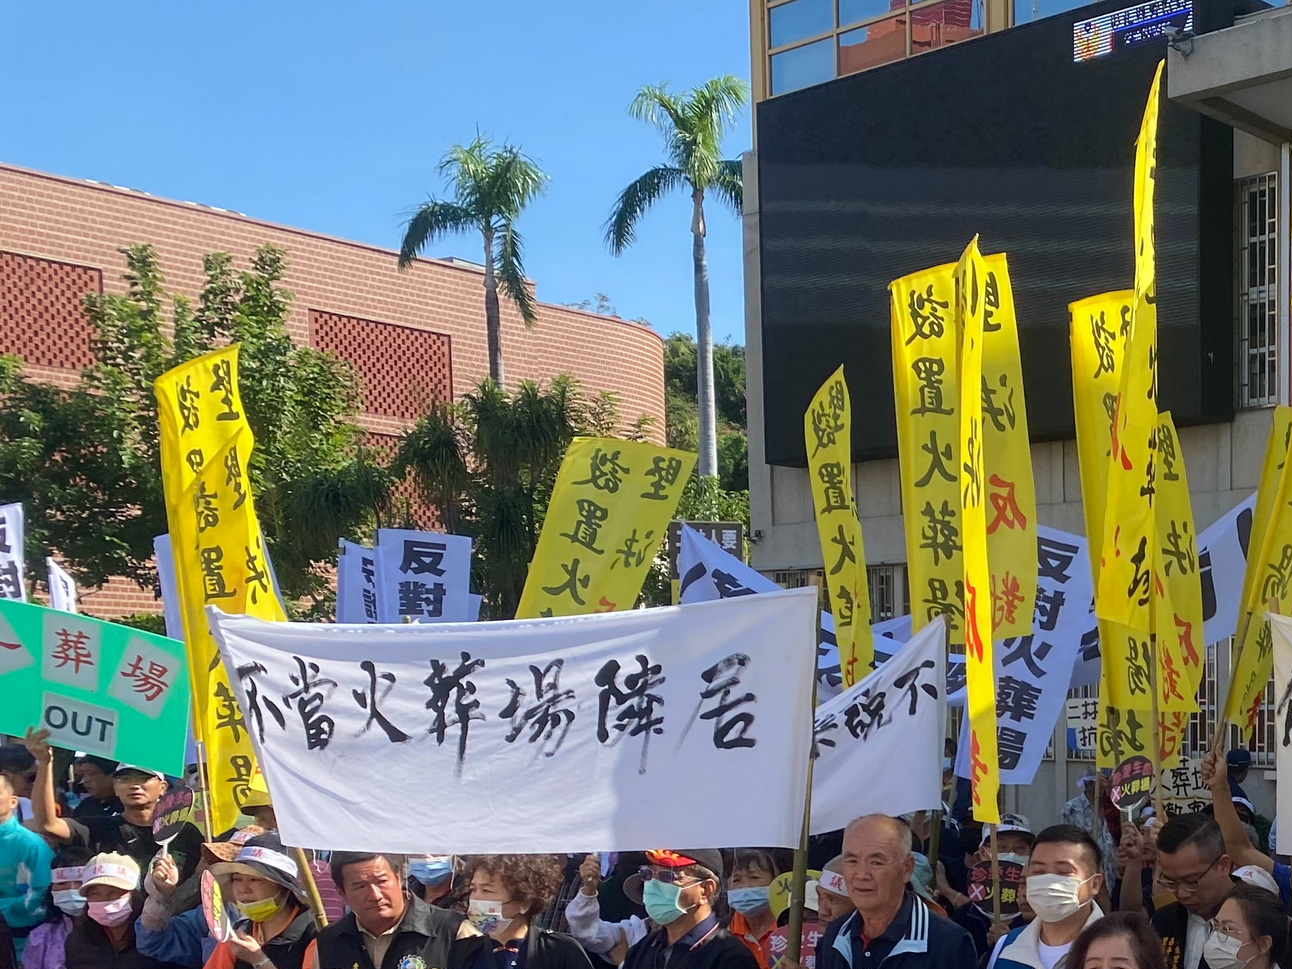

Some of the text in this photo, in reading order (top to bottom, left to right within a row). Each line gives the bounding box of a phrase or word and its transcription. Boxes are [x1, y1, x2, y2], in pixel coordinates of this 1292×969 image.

[399, 539, 447, 618] 反對
[0, 628, 169, 702] 葬場
[44, 705, 114, 742] OUT
[770, 931, 823, 952] 珍生
